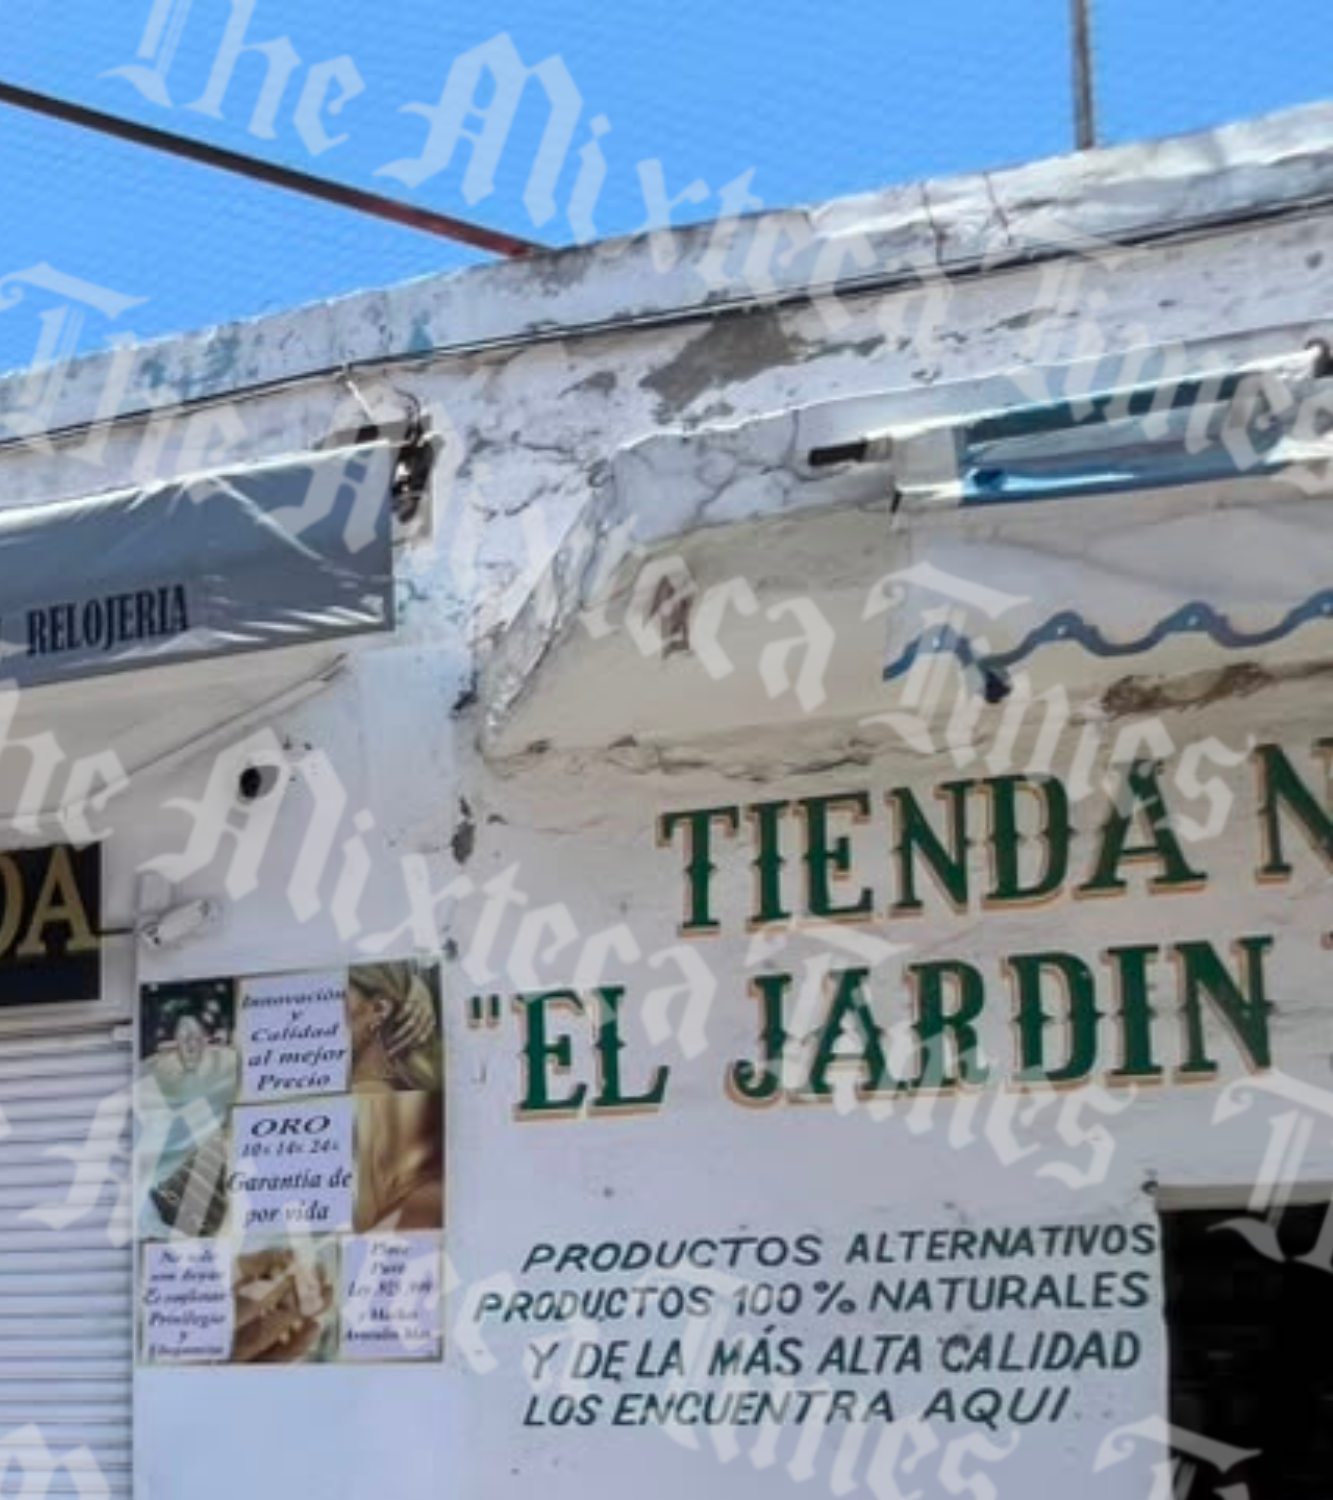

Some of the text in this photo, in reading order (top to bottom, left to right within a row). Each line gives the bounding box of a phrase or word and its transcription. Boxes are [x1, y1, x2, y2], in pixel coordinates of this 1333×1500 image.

[655, 758, 1208, 940] TIENDA
[250, 1022, 340, 1042] Calidad
[724, 934, 1275, 1108] JARDIN
[247, 1045, 347, 1067] al mejor
[257, 1071, 332, 1092] Precio
[251, 1115, 331, 1137] ORO
[328, 1165, 353, 1189] de
[284, 1199, 330, 1220] vida
[521, 1222, 1157, 1274] PRODUCTOS ALTERNATIVOS
[472, 1285, 714, 1323] PRODUCTOS
[869, 1271, 1152, 1313] NATURALES
[529, 1323, 1142, 1382] Y DE LA MÁS ALTA CALIDAD
[522, 1385, 1072, 1432] LOS ENCUENTRA AQUI
